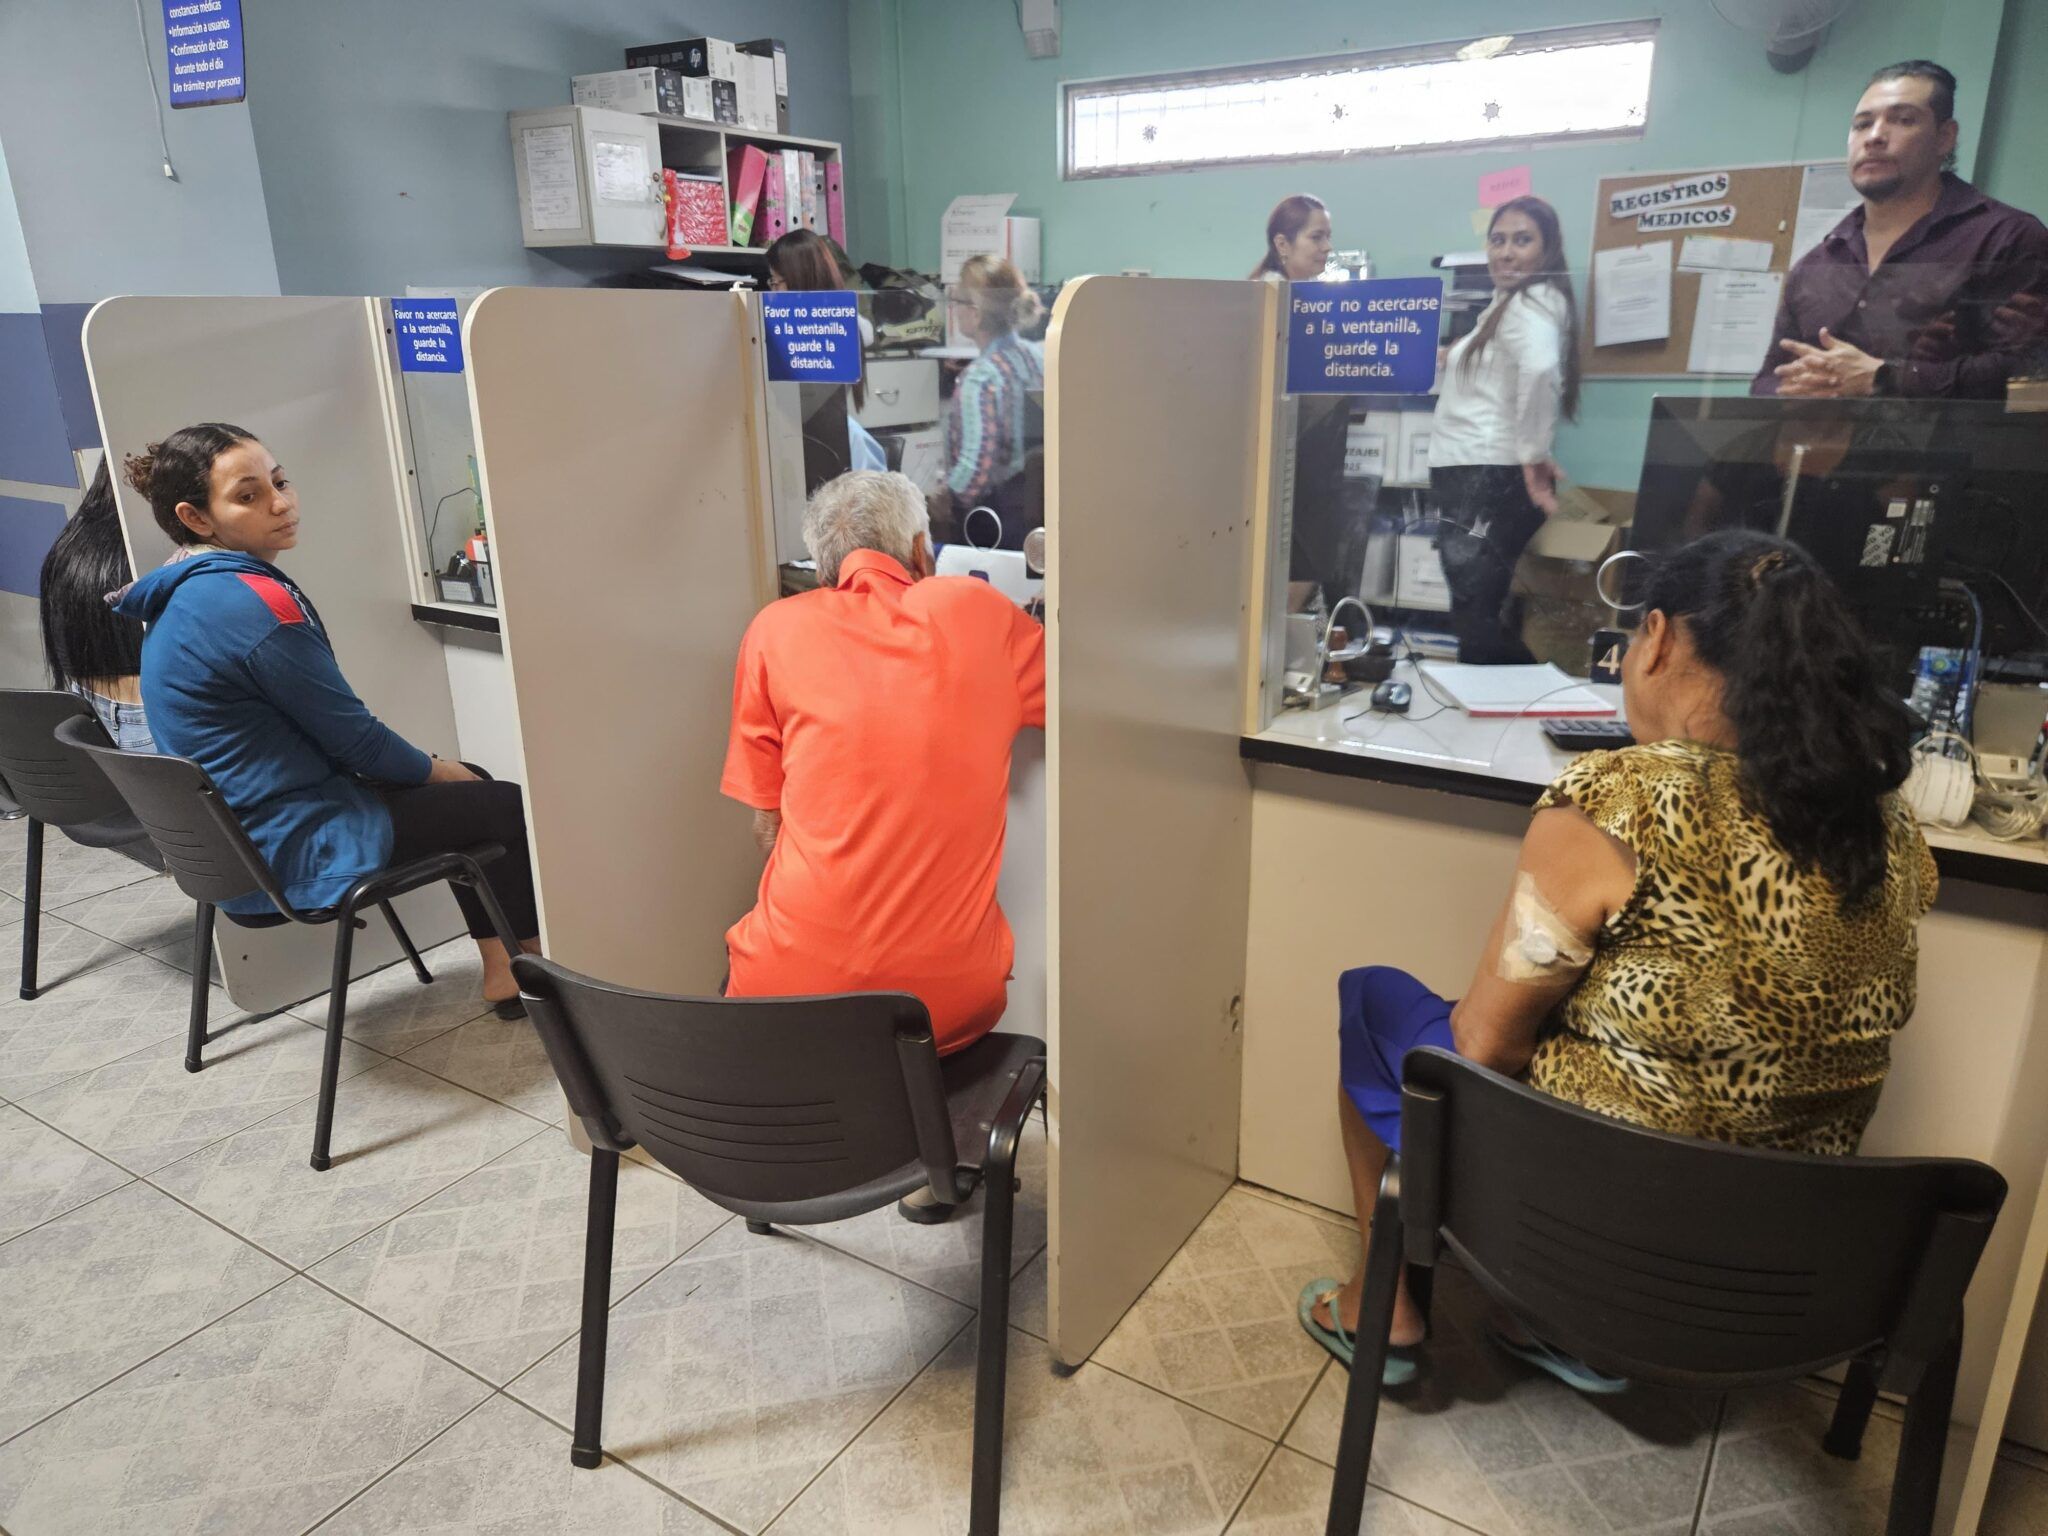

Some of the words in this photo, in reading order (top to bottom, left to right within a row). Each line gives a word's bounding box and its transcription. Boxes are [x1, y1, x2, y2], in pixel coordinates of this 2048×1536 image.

[170, 3, 199, 18] constancias
[208, 19, 230, 31] usuarios
[209, 40, 216, 51] de
[217, 38, 228, 50] citas
[175, 61, 195, 74] durante
[196, 60, 208, 72] todo
[210, 59, 214, 70] el
[215, 57, 224, 70] día
[174, 82, 182, 93] Un
[184, 80, 205, 92] trámite
[206, 80, 216, 92] por
[218, 76, 240, 90] persona
[1611, 176, 1726, 213] REGISTROS
[1639, 207, 1731, 228] MEDICOS
[764, 306, 790, 318] Favor
[794, 308, 807, 318] no
[811, 307, 856, 318] acercarse
[1293, 299, 1332, 313] Favor
[1340, 300, 1360, 312] no
[1368, 298, 1438, 312] acercarse
[394, 309, 412, 319] Favor
[415, 311, 424, 319] no
[426, 311, 457, 320] acercarse
[402, 325, 408, 333] a
[409, 323, 416, 333] la
[418, 323, 453, 335] ventanilla,
[774, 325, 780, 335] a
[784, 322, 794, 335] la
[797, 322, 847, 336] ventanilla,
[1306, 324, 1314, 335] a
[1322, 319, 1335, 334] la
[1342, 316, 1421, 335] ventanilla,
[413, 338, 437, 350] guarde
[439, 338, 446, 348] la
[788, 339, 821, 355] guarde
[826, 339, 835, 352] la
[1324, 340, 1377, 360] guarde
[1385, 340, 1399, 355] la
[416, 351, 448, 362] distancia.
[790, 357, 835, 369] distancia.
[1325, 362, 1395, 377] distancia.
[1597, 643, 1620, 675] 4
